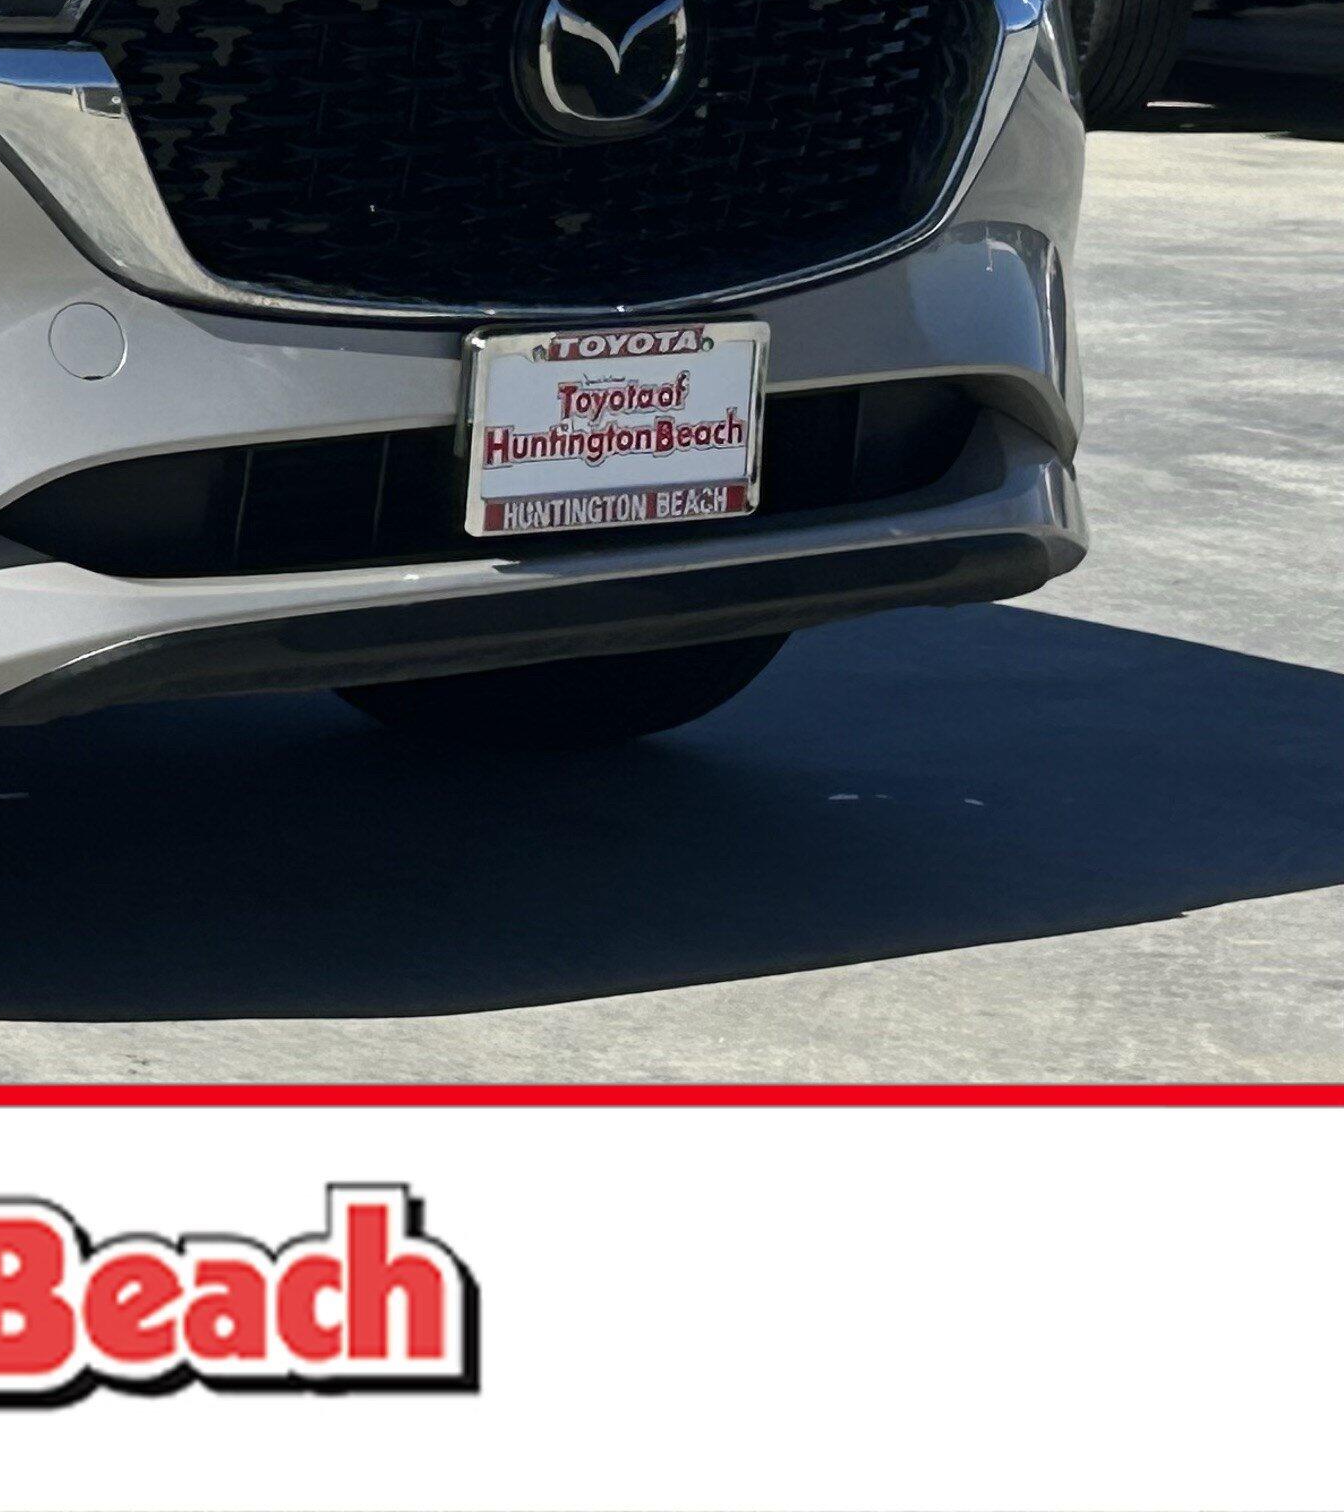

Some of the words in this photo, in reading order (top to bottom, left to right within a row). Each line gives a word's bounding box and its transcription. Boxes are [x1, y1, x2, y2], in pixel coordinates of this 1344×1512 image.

[554, 331, 698, 359] TOYOTA
[559, 385, 654, 422] Toyota
[657, 371, 690, 409] of
[485, 420, 649, 465] Huntington
[655, 408, 744, 453] Beach
[503, 491, 647, 530] HUNTINGTON
[657, 486, 728, 517] BEACH
